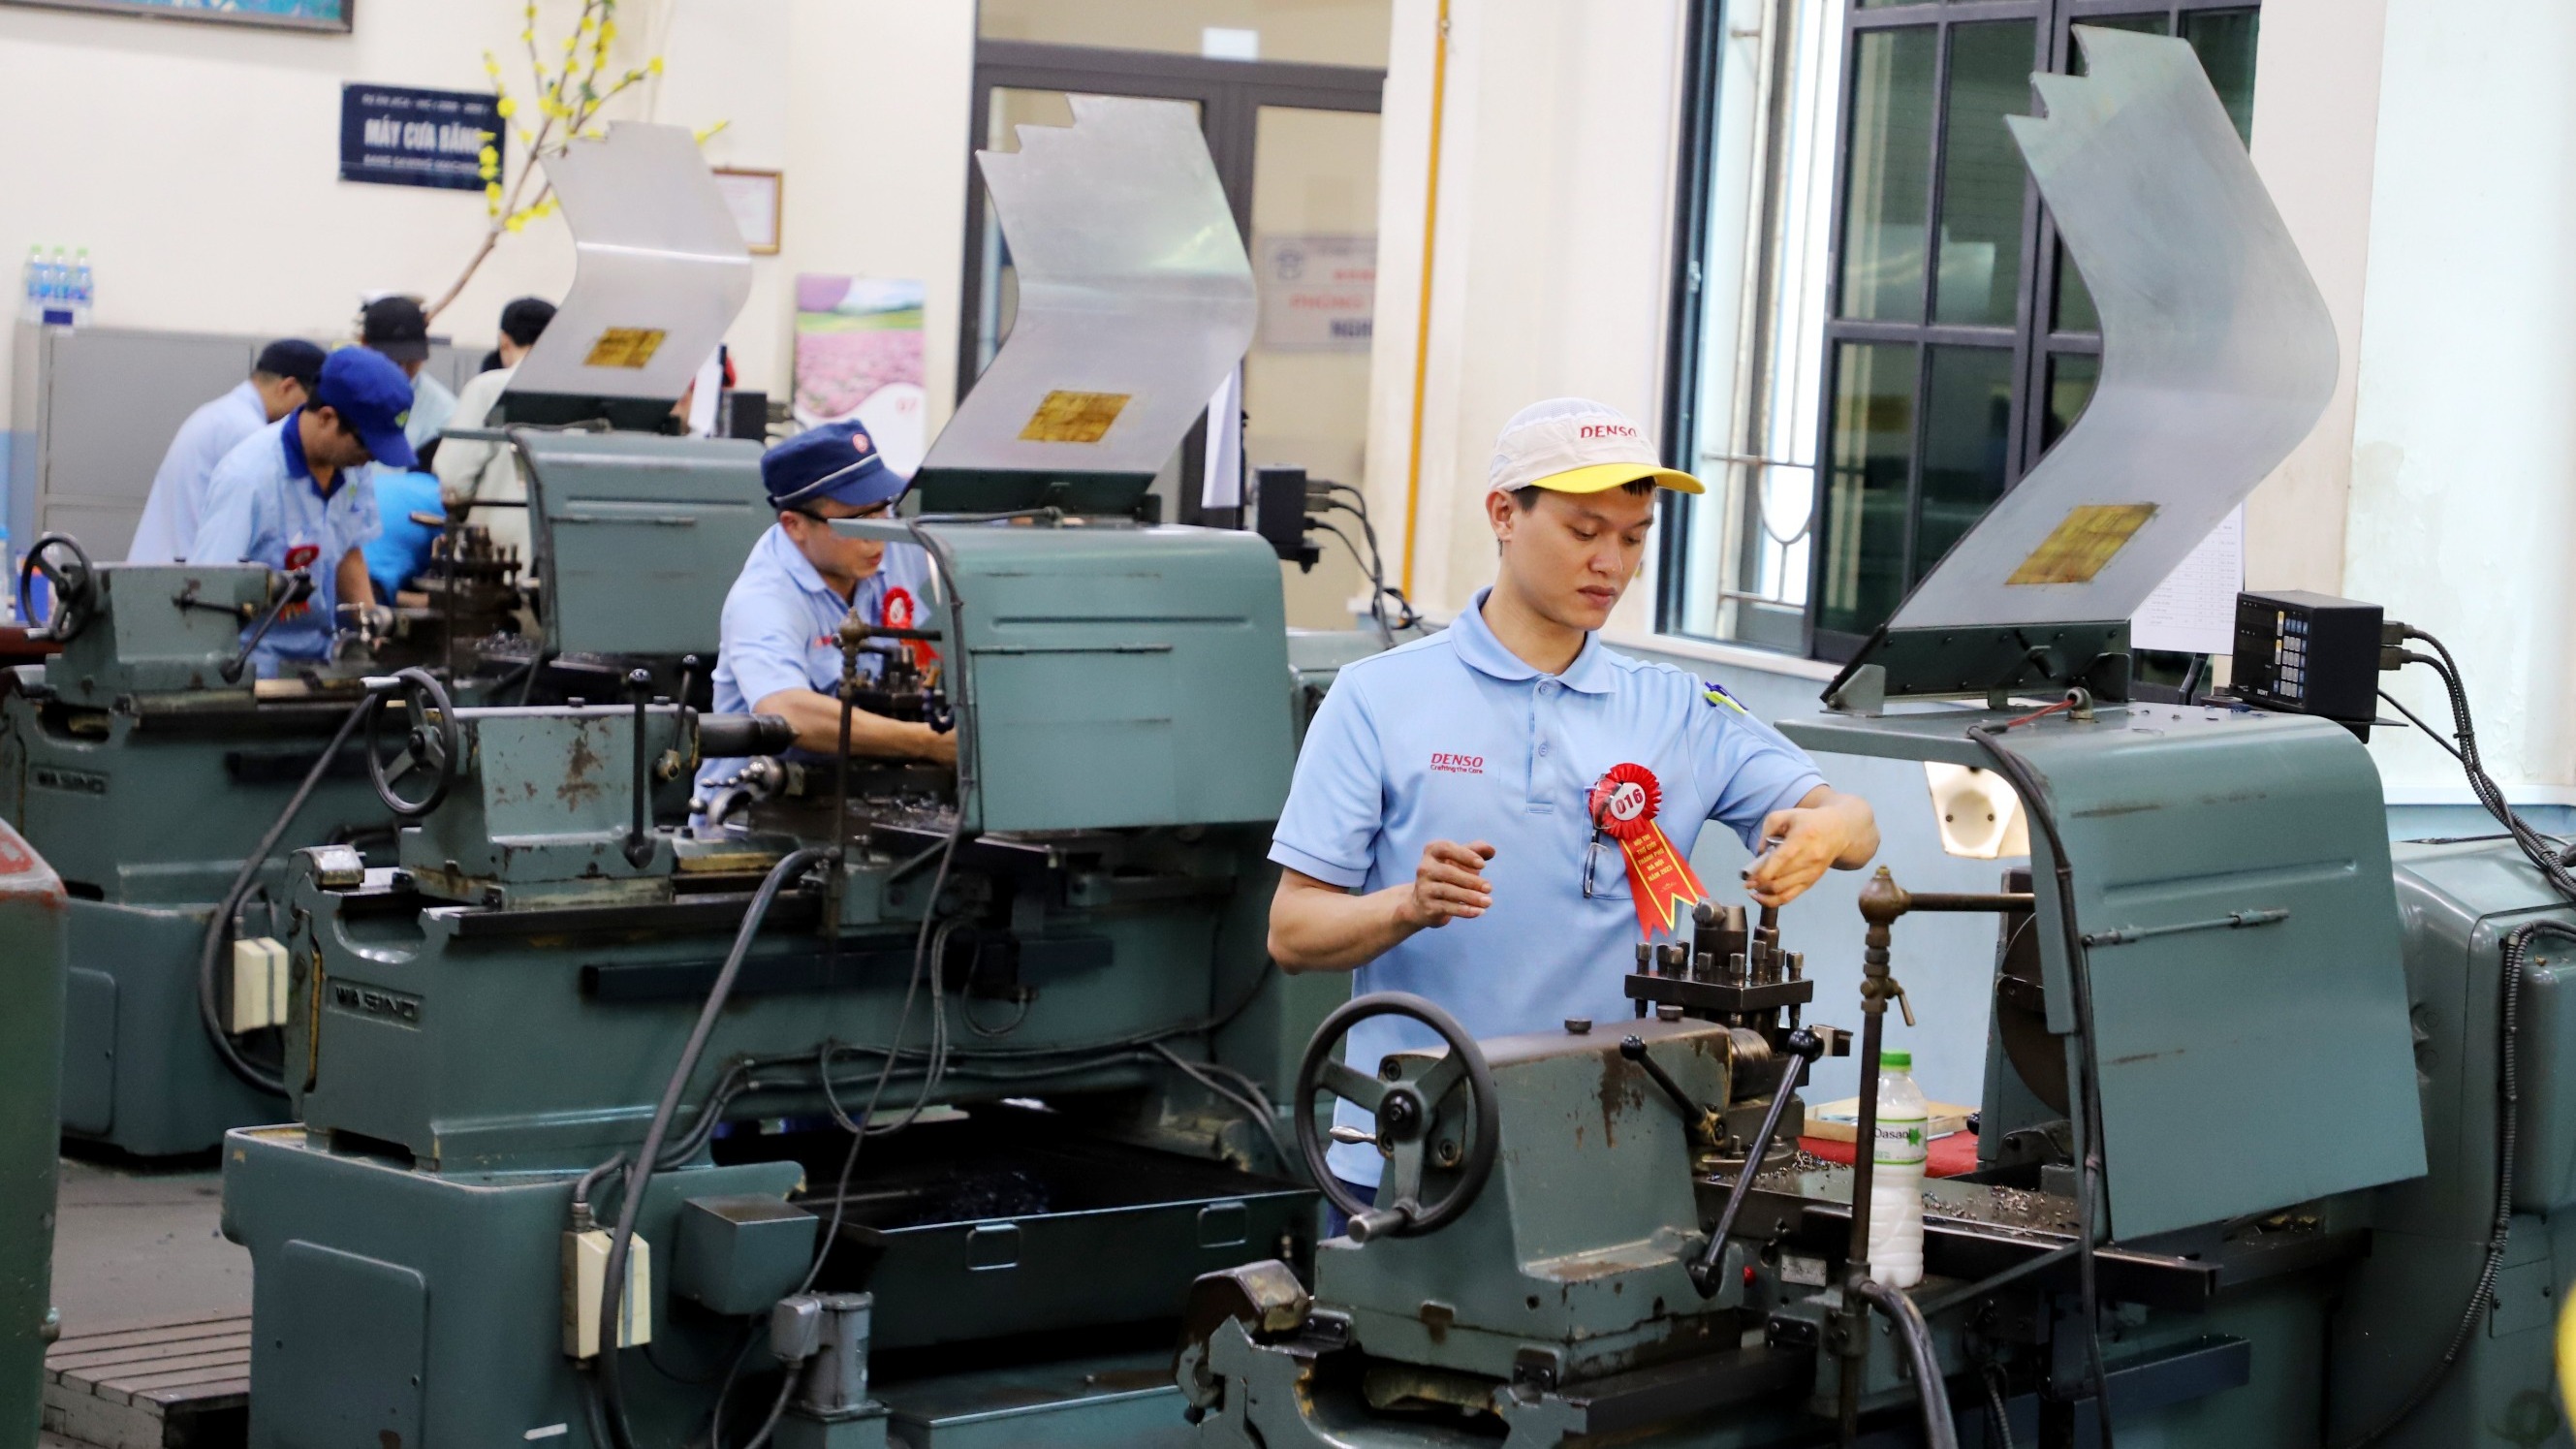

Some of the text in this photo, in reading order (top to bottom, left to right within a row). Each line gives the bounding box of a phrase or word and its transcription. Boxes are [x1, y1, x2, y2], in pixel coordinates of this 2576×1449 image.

[1429, 764, 1457, 773] Crafting
[1430, 753, 1484, 768] DENSO
[1615, 788, 1644, 814] 016
[334, 984, 420, 1023] WASINO
